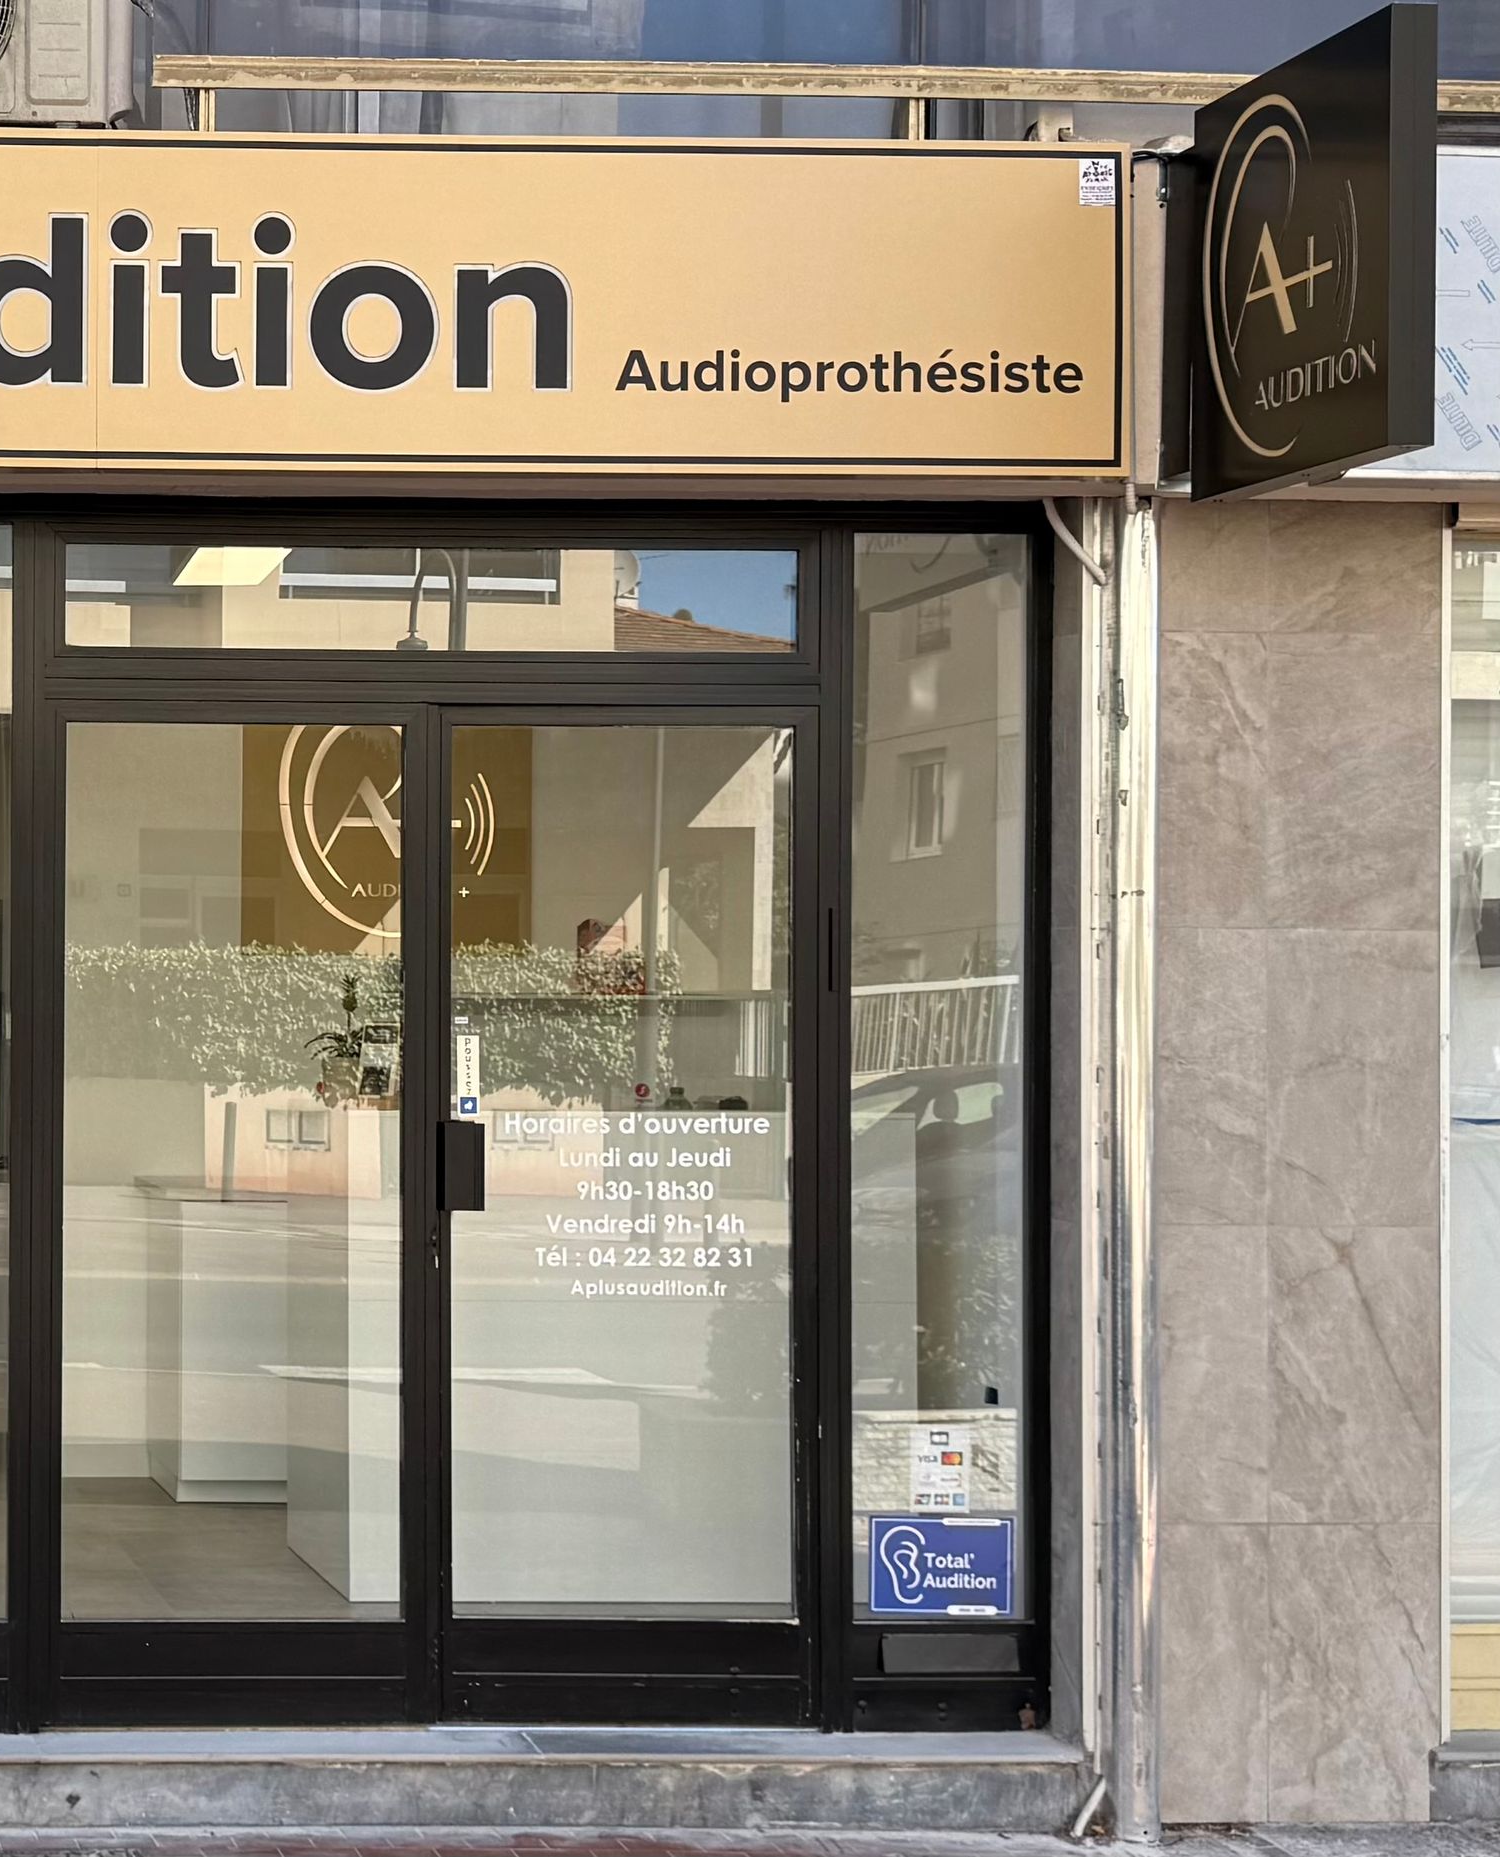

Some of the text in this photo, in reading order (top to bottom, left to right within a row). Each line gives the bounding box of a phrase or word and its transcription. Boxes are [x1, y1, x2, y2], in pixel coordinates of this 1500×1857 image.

[1232, 220, 1333, 345] A+
[615, 349, 1084, 403] Audioprothésiste
[1255, 340, 1377, 410] AUDITION
[504, 1112, 771, 1135] Horaires d'ouverture
[559, 1147, 732, 1168] Lundi au Jeudi
[576, 1180, 715, 1201] 9h30-18h30
[546, 1214, 745, 1235] Vendredi 9h-14h
[535, 1244, 568, 1267] Tél
[588, 1247, 617, 1267] 04
[623, 1247, 651, 1267] 22
[658, 1247, 686, 1268] 32
[693, 1247, 721, 1268] 82
[727, 1247, 753, 1268] 31
[570, 1279, 728, 1299] Aplusaudition.fr
[922, 1573, 997, 1590] Audition
